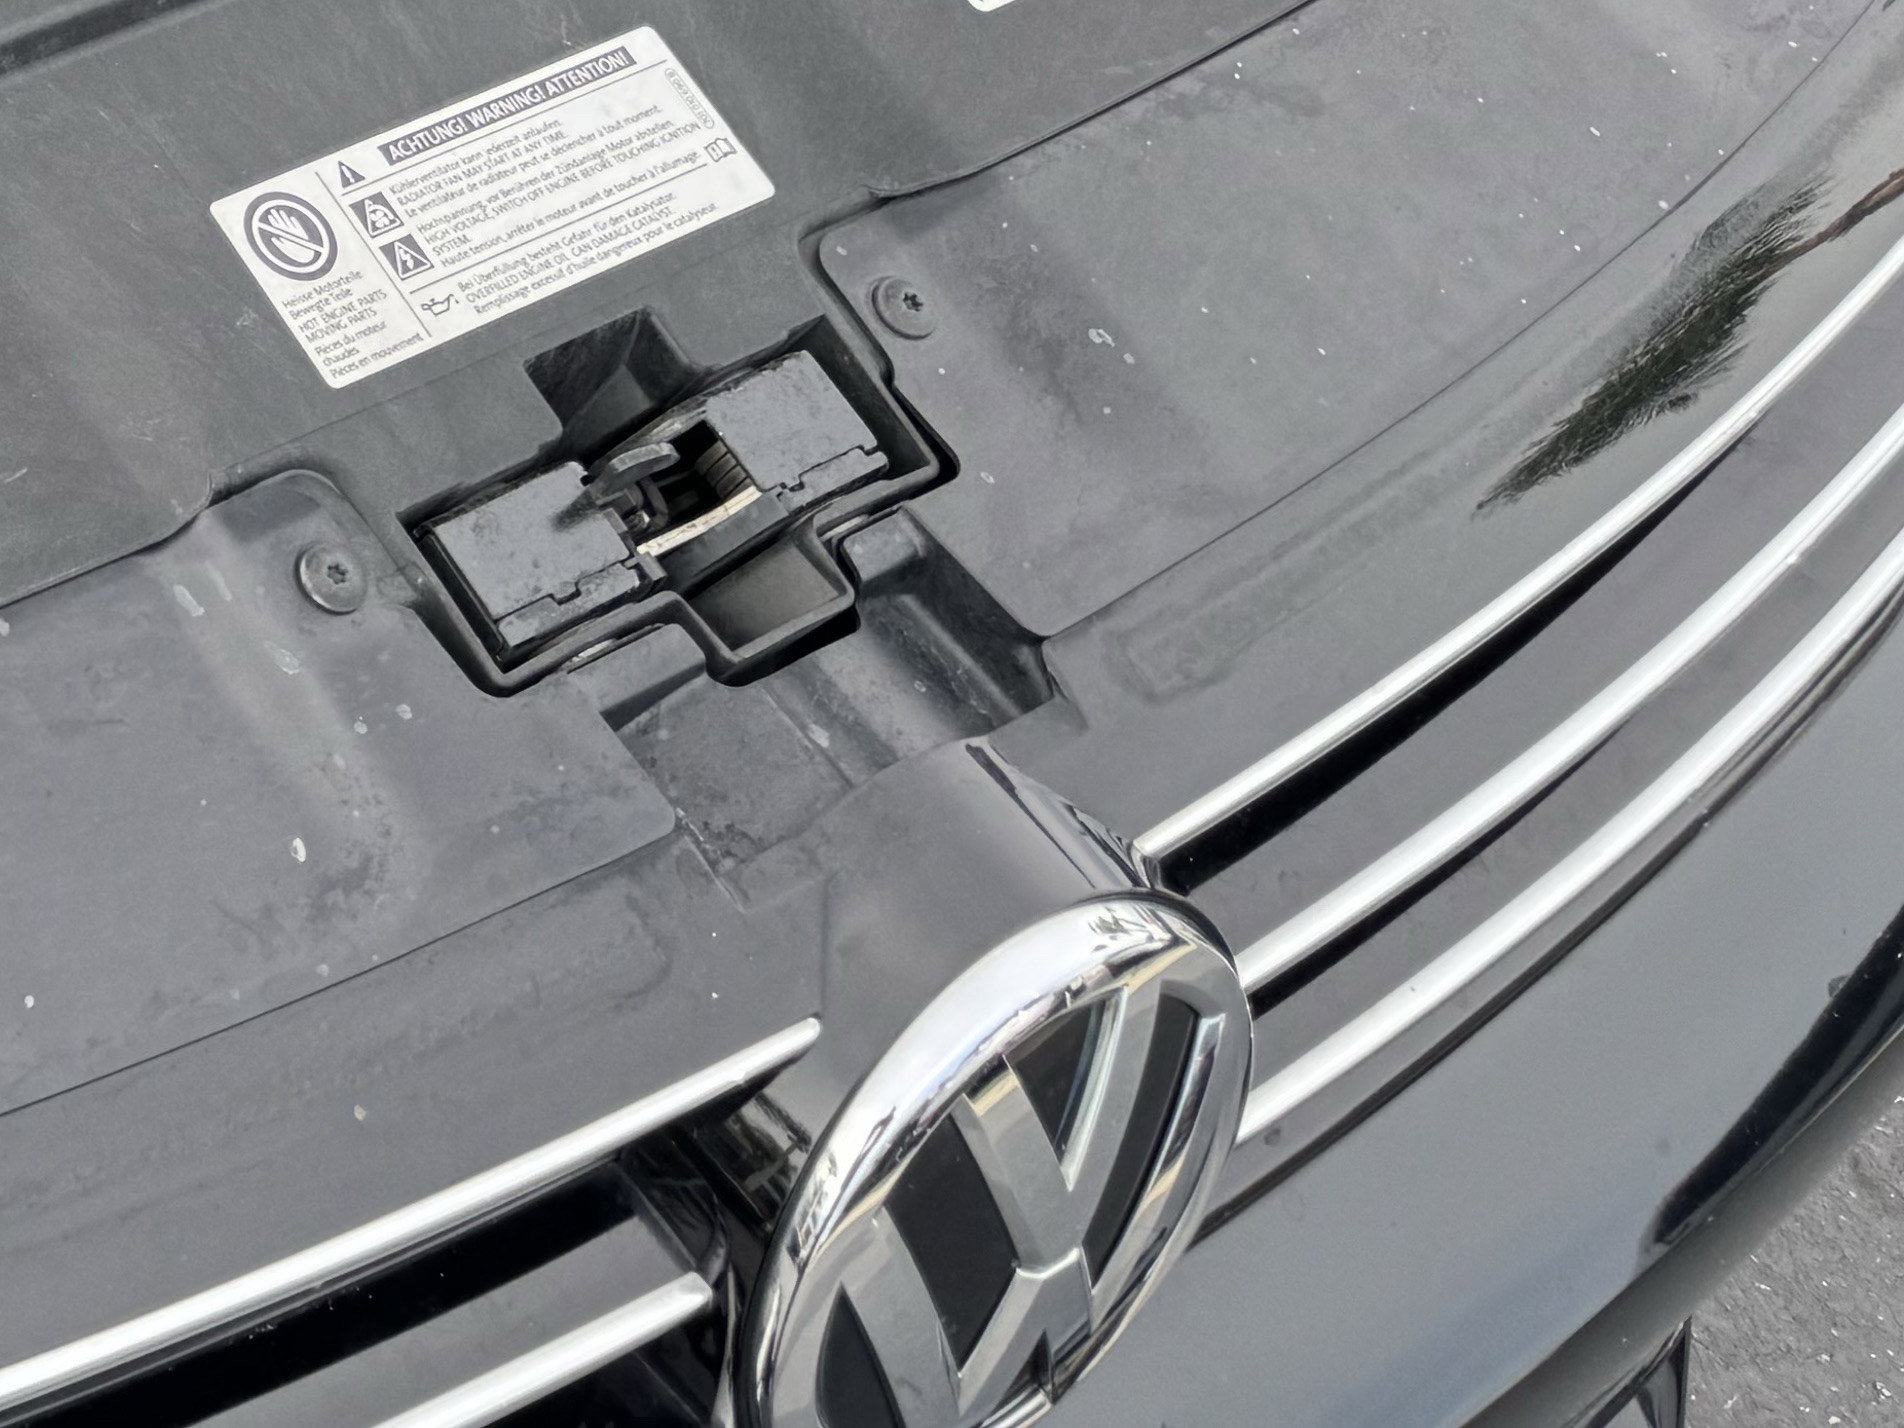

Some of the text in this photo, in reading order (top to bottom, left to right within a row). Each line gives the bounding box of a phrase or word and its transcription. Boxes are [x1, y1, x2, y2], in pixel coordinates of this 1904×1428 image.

[389, 51, 629, 160] ACHTUNG! WARNING! ATTENTION!
[396, 181, 444, 206] RADIATOR
[442, 175, 463, 186] FAN
[461, 164, 484, 178] MAY
[483, 152, 510, 171] START
[511, 147, 523, 159] AT
[523, 140, 542, 154] ANY
[404, 208, 418, 218] Le
[417, 187, 465, 213] ventilateur
[466, 182, 479, 193] de
[478, 165, 518, 187] radiateur
[518, 155, 540, 172] peut
[539, 152, 551, 162] se
[551, 132, 596, 157] déclencher
[602, 120, 624, 134] tout
[459, 151, 484, 165] kann
[485, 135, 522, 158] jederzeit
[486, 193, 500, 205] vor
[498, 176, 541, 199] Berühren
[540, 170, 555, 181] der
[555, 148, 606, 175] Zündanlage
[604, 136, 634, 152] Motor
[423, 228, 451, 245] HIGH
[491, 196, 529, 216] SWITCH
[527, 187, 544, 202] OFF
[544, 172, 580, 194] ENGINE
[579, 158, 614, 179] BEFORE
[612, 138, 661, 163] TOUCHING
[659, 122, 701, 144] IGNITION
[440, 250, 471, 268] Haute
[505, 222, 535, 240] arrêter
[533, 218, 545, 227] le
[544, 204, 577, 222] moteur
[578, 191, 604, 209] avant
[603, 188, 616, 198] de
[613, 173, 648, 193] toucher
[457, 279, 475, 293] Bei
[526, 241, 563, 262] besteht
[561, 228, 592, 247] Gefahr
[592, 221, 608, 232] für
[608, 214, 627, 227] den
[281, 271, 363, 309] Heisse Motorteile
[465, 274, 520, 303] OVERFILLED
[518, 259, 554, 281] ENGINE
[570, 242, 593, 257] CAN
[591, 224, 633, 249] DAMAGE
[473, 286, 531, 314] Remplissage
[530, 268, 566, 290] excessif
[596, 236, 643, 261] dangereux
[642, 226, 664, 243] pour
[662, 222, 674, 230] le
[289, 288, 353, 320] Bewegte Teile
[298, 288, 387, 333] HOT ENGINE PARTS
[305, 306, 377, 343] MOVING PARTS
[342, 334, 356, 345] du
[355, 321, 387, 340] moteur
[322, 346, 360, 367] chaudes
[358, 356, 371, 367] en
[370, 332, 424, 360] mouvement
